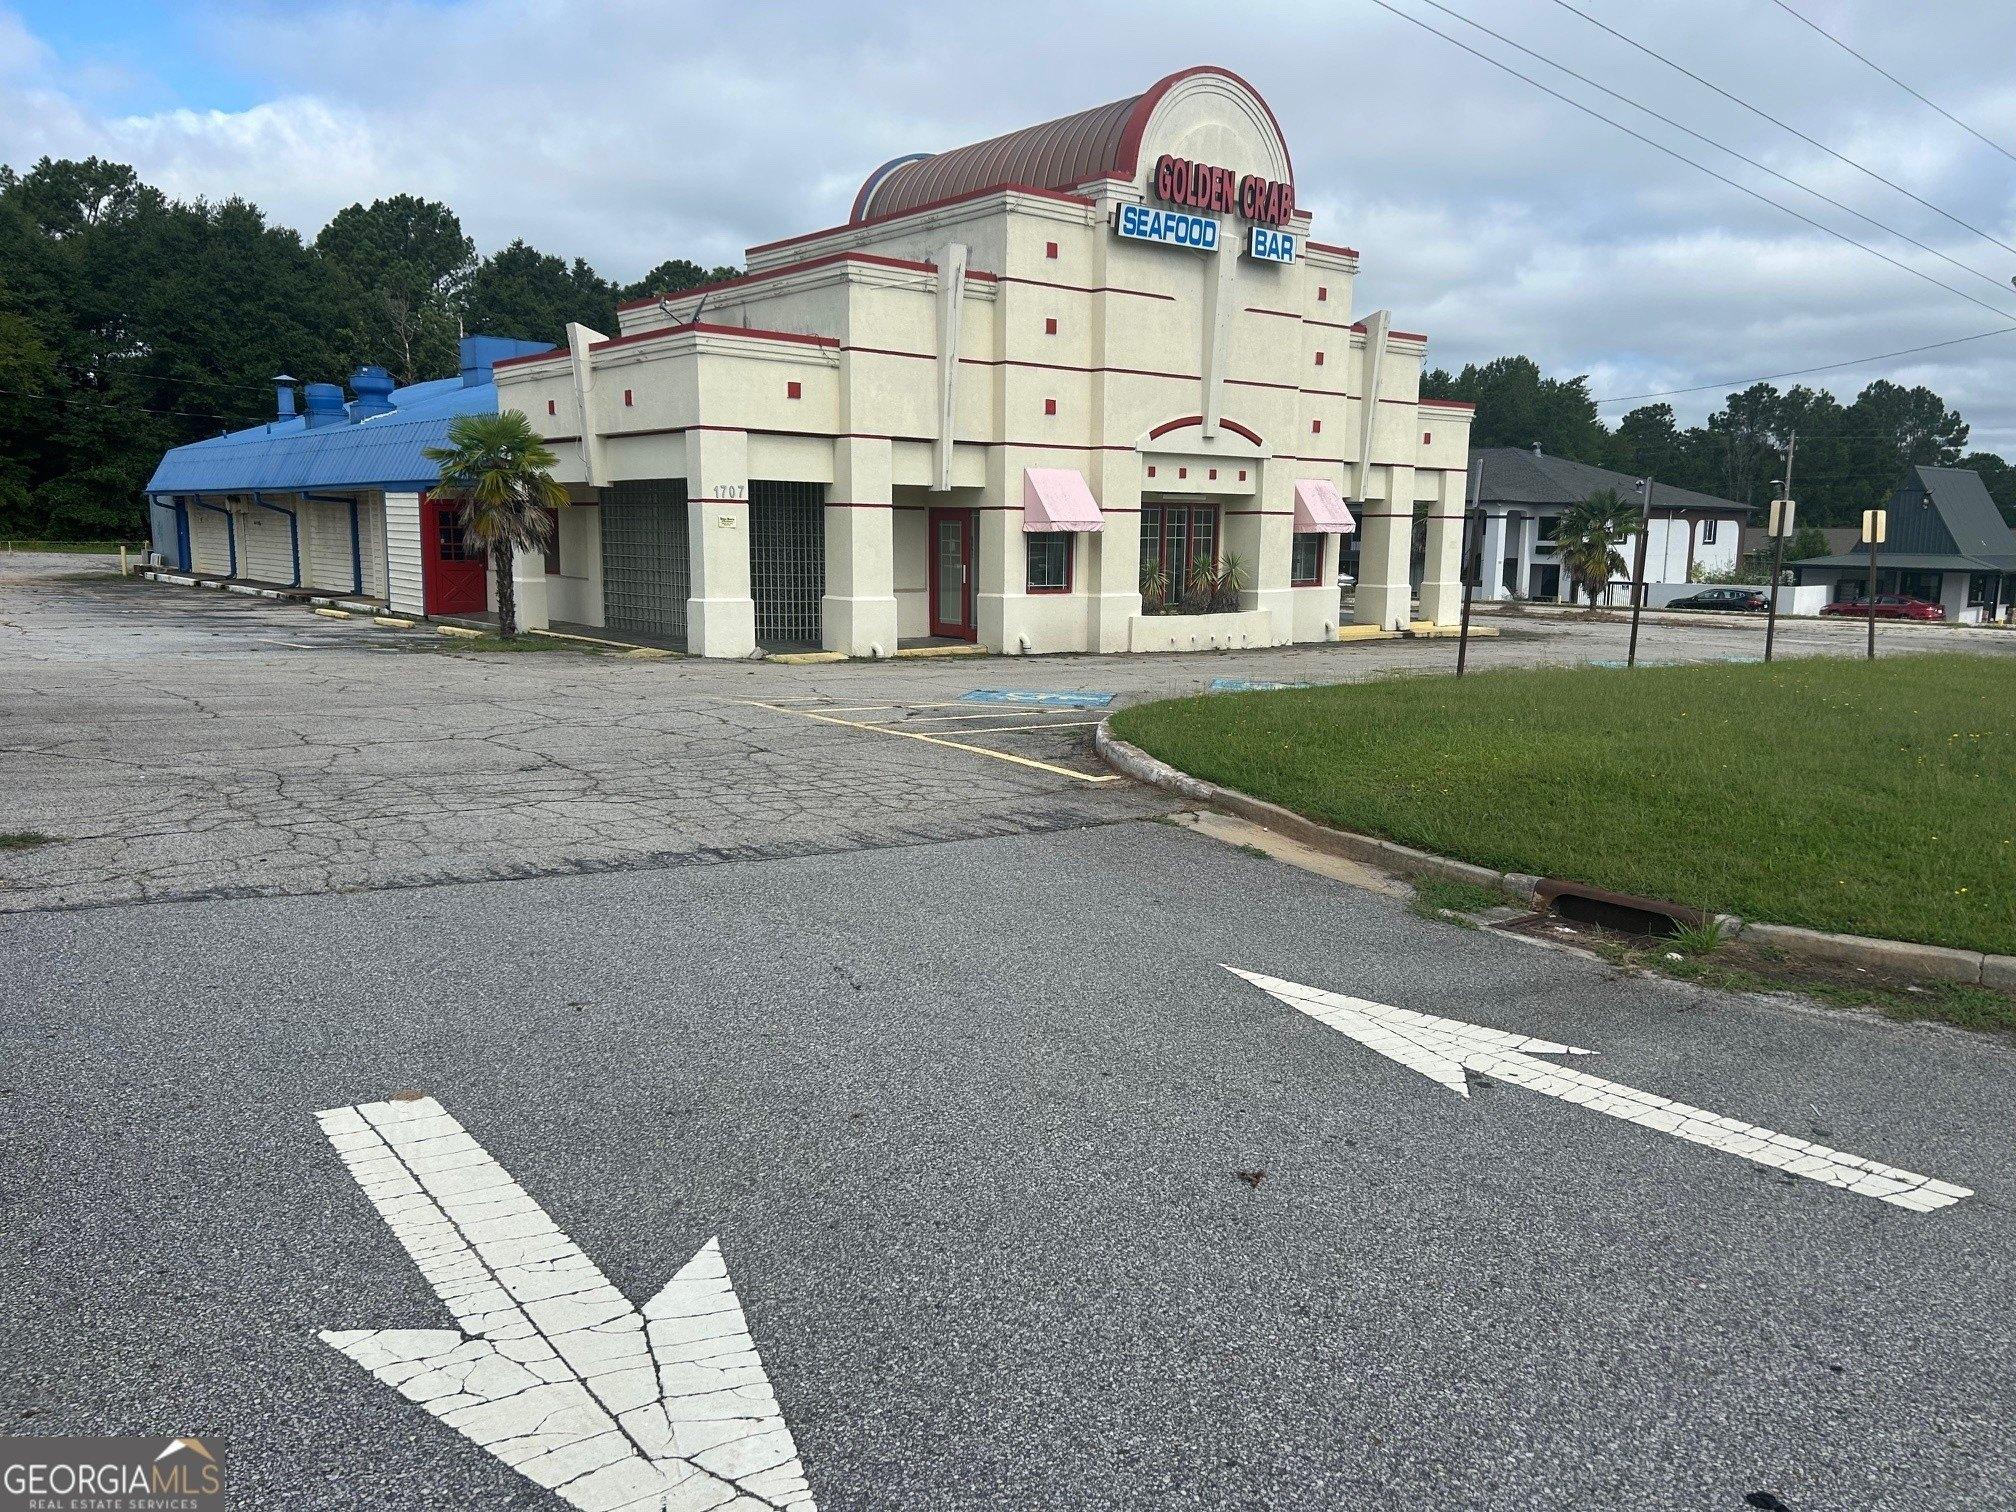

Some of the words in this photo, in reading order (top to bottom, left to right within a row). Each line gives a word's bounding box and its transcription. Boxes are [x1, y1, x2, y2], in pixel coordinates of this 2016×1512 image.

[1155, 154, 1236, 214] GOLDEN
[1239, 175, 1294, 226] CRAB
[1123, 206, 1216, 248] SEAFOOD
[1255, 229, 1294, 262] BAR
[714, 485, 745, 499] 1707
